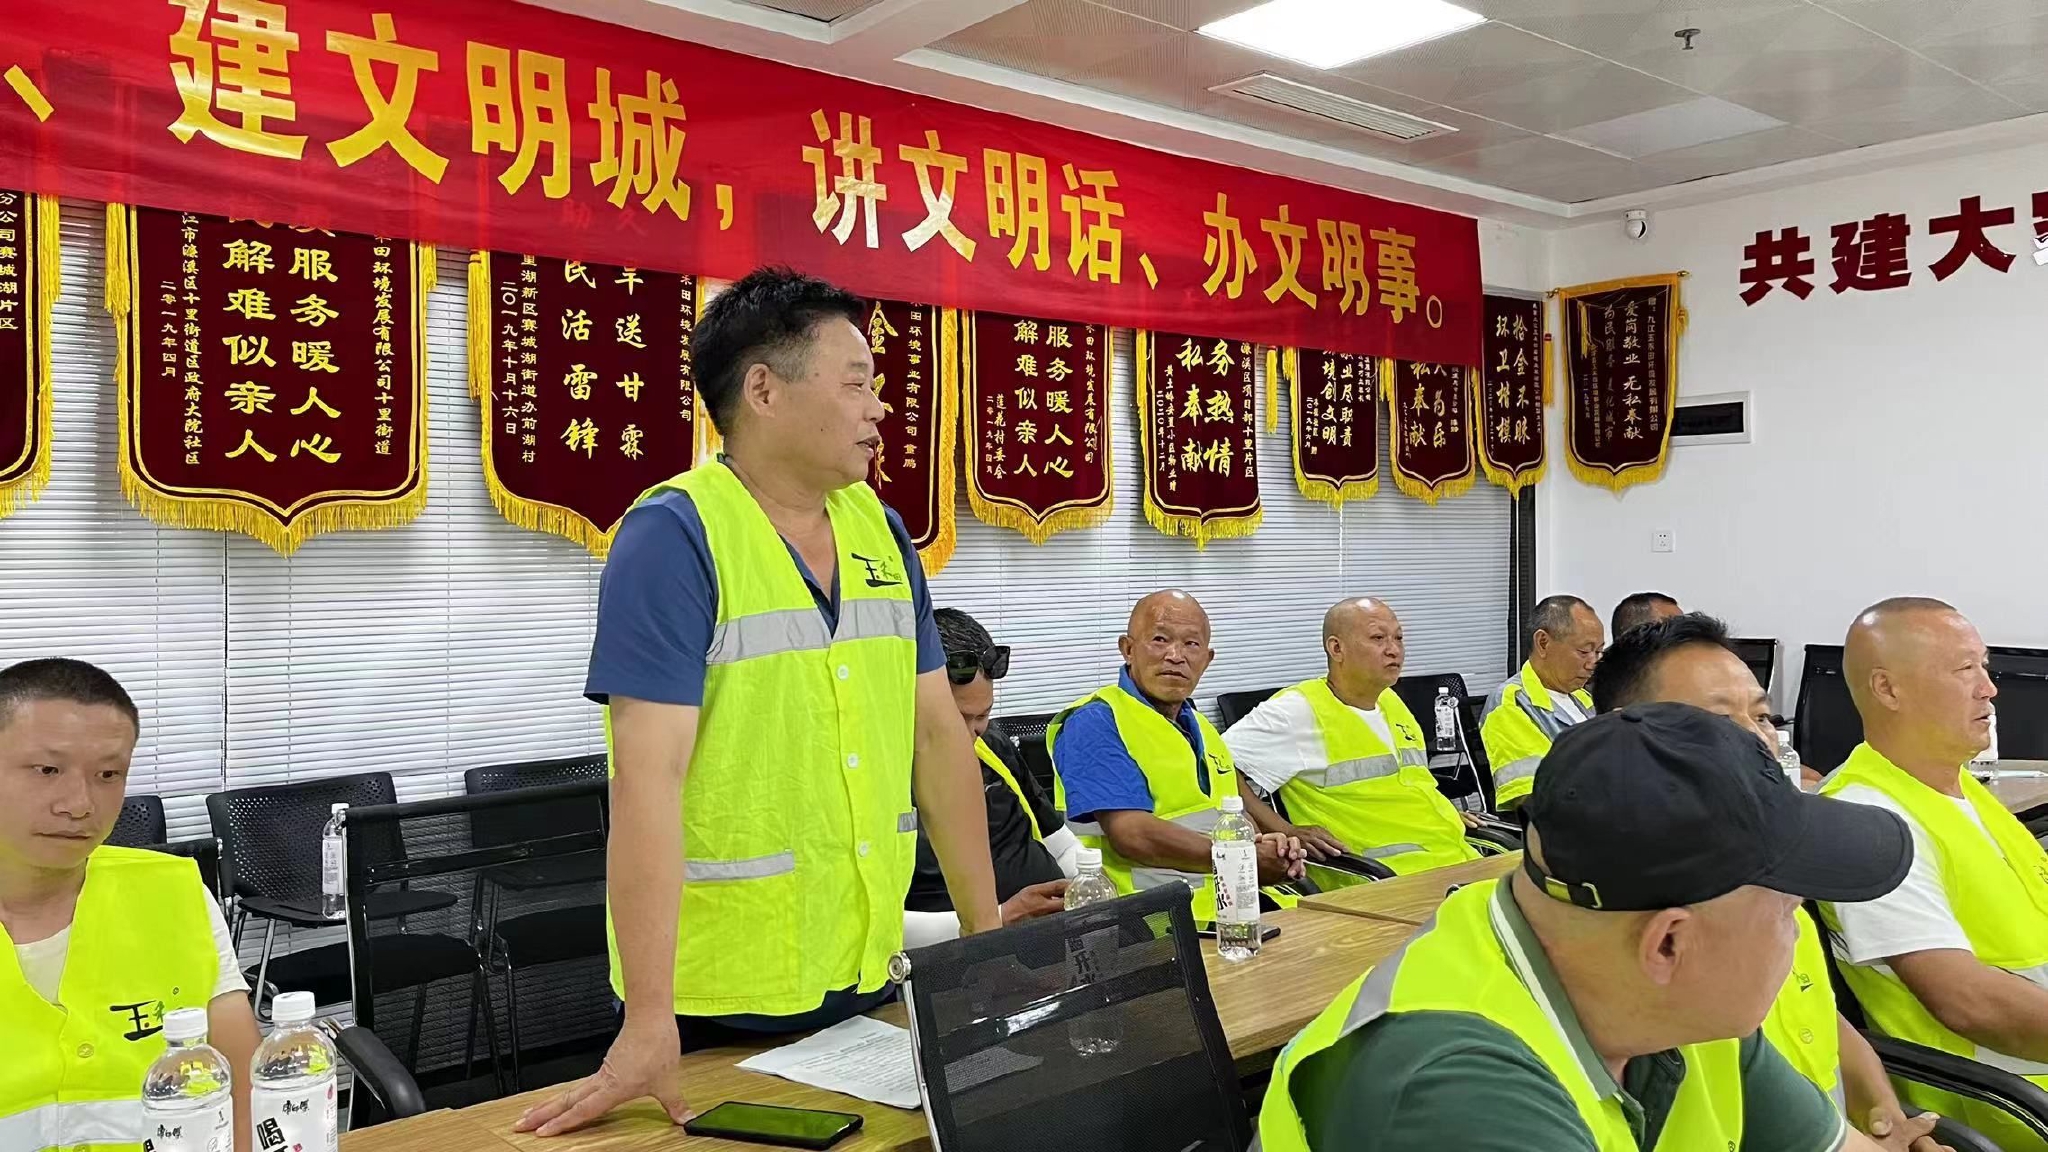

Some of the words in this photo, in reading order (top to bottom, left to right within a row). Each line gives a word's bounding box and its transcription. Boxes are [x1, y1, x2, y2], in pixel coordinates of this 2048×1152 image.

[222, 216, 277, 463] 解难似亲人
[289, 223, 342, 464] 服务暖人心
[1013, 319, 1039, 477] 解难似亲人
[1044, 324, 1074, 478] 服务暖人心
[1174, 337, 1204, 473] 私奉献
[1204, 338, 1236, 478] 务热情
